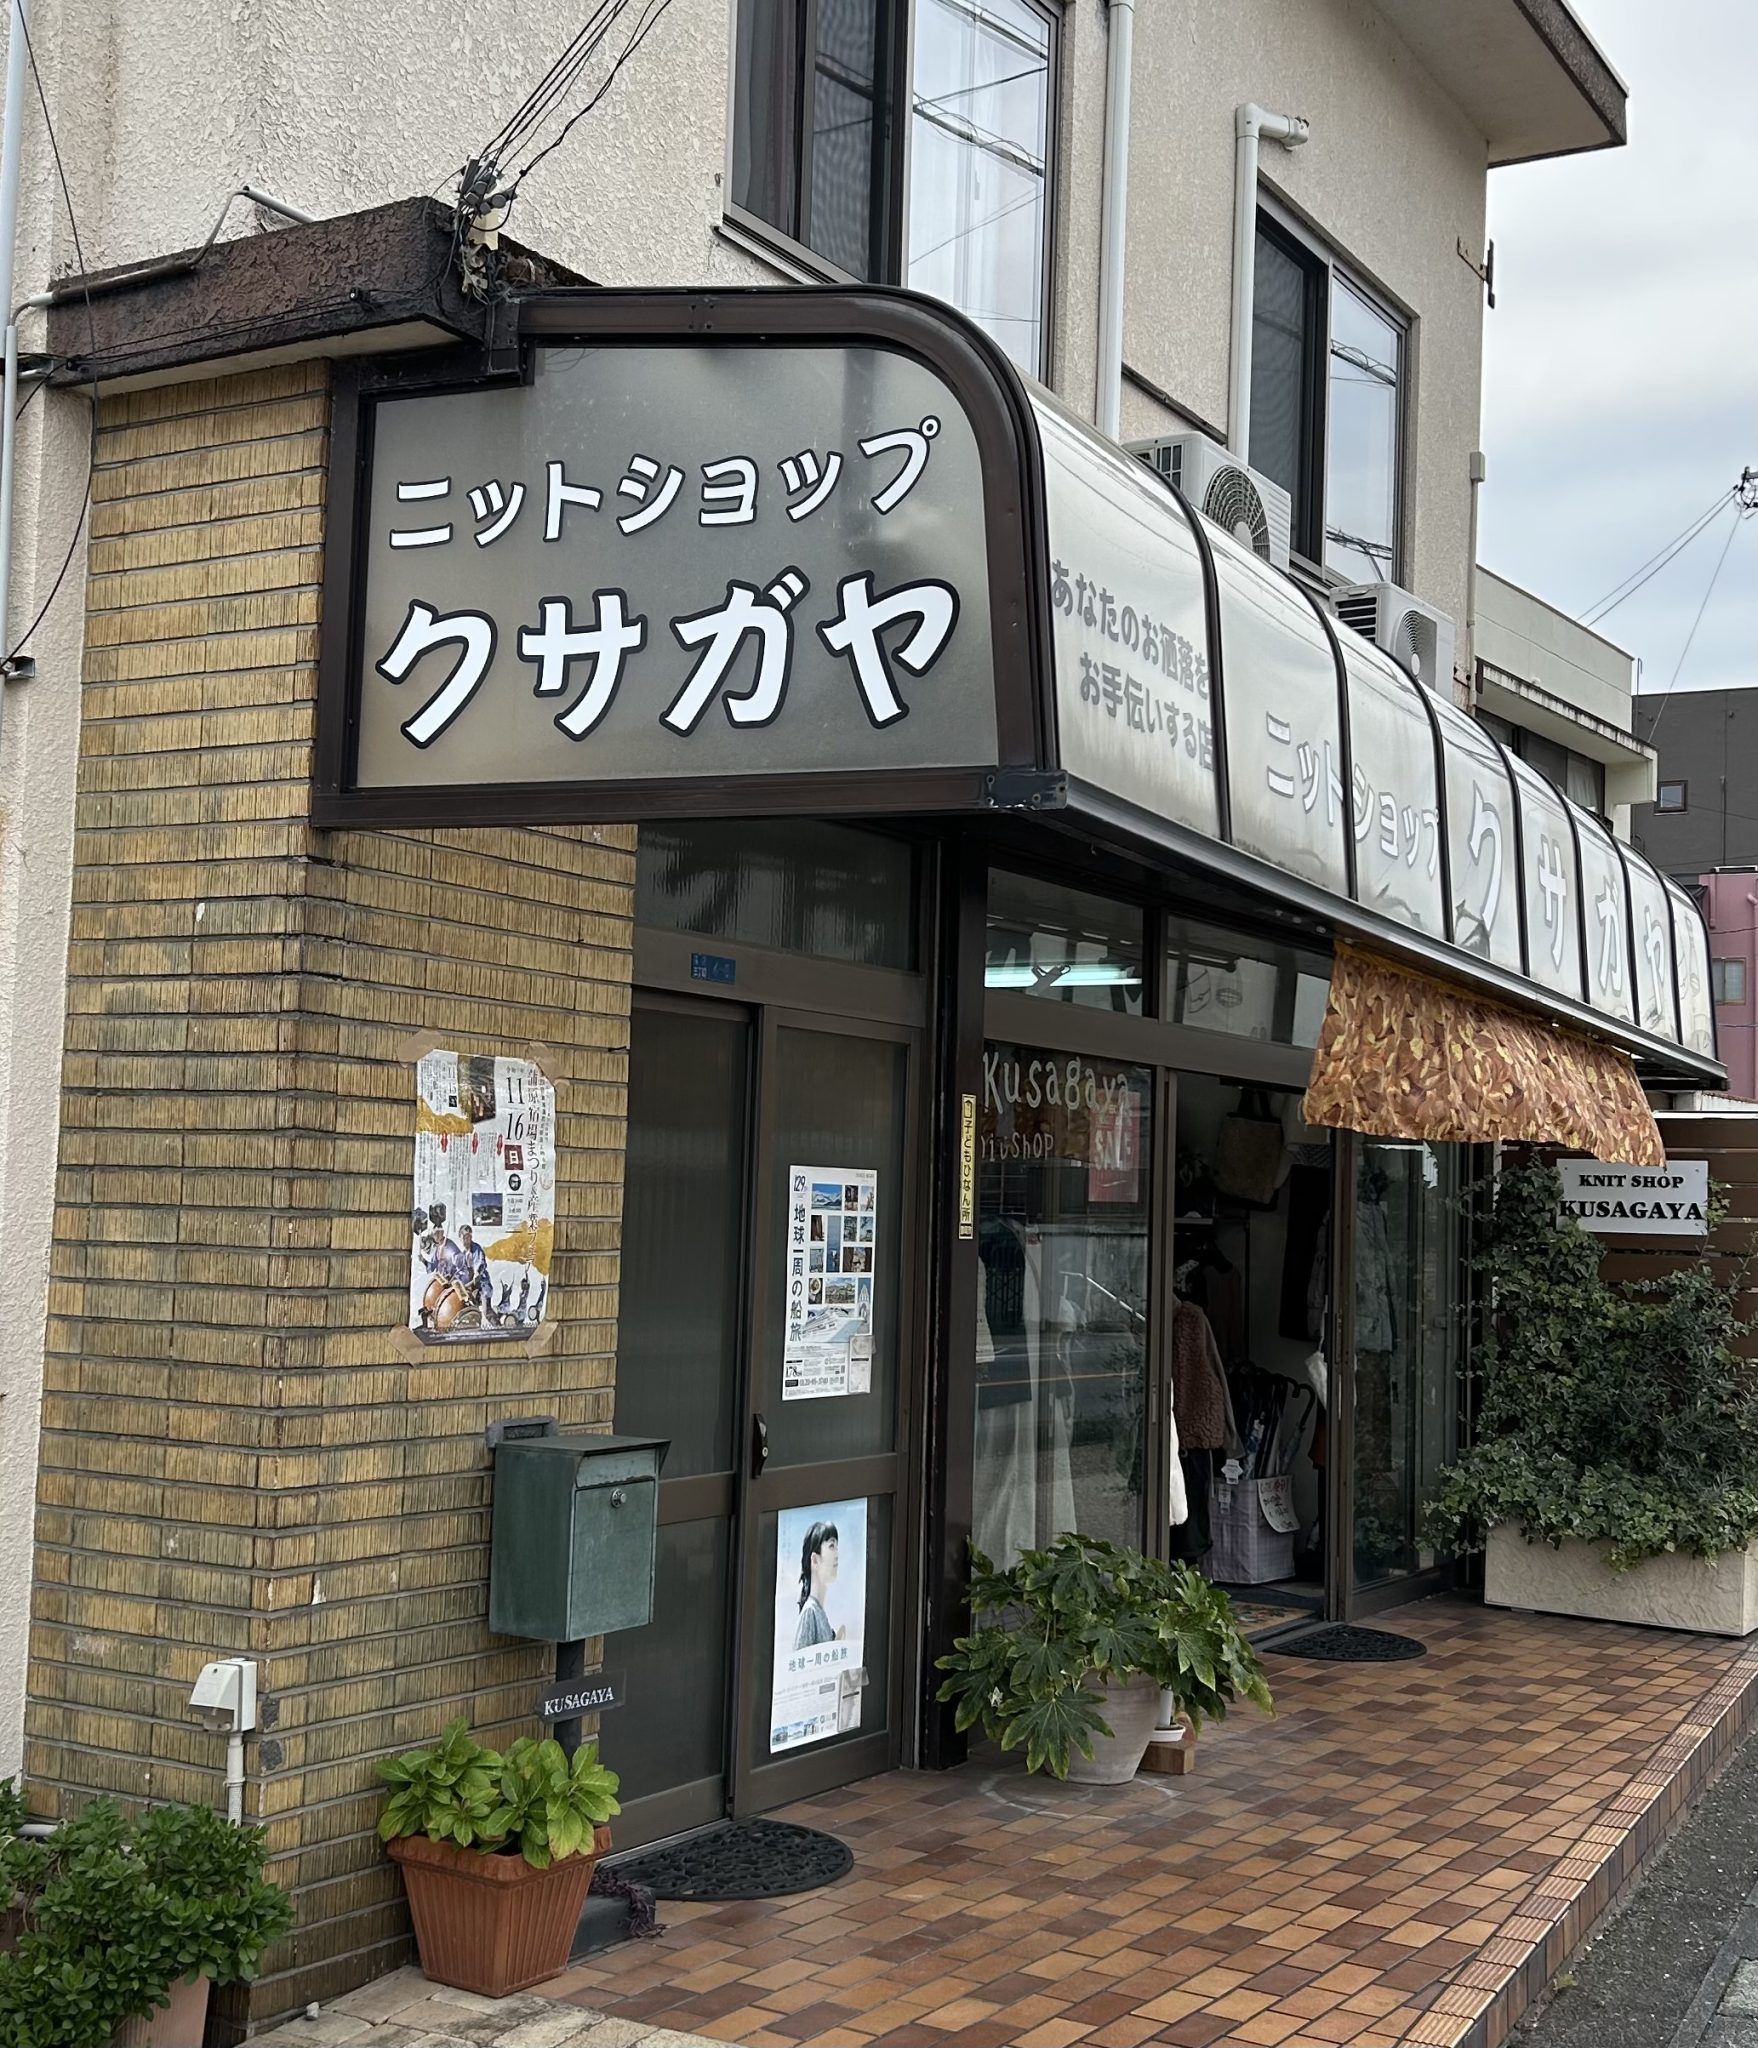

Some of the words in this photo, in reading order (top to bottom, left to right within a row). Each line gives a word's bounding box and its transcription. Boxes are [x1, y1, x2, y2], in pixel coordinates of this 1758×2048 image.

[390, 415, 940, 548] ニットショップ
[1052, 559, 1210, 701] あなたのお洒落を
[376, 565, 960, 748] クサガヤ
[1266, 711, 1440, 881] ニットショップ
[1467, 780, 1665, 1020] クサガヤ
[505, 1077, 525, 1105] 11
[983, 1052, 1129, 1122] Kusagaya
[505, 1112, 525, 1140] 16
[1578, 1174, 1627, 1188] KNIT
[1631, 1175, 1684, 1189] SHOP
[1559, 1200, 1704, 1220] KUSAGAYA
[790, 1203, 806, 1341] 地球一周の船旅
[788, 1647, 848, 1672] 地球一周の船旅
[543, 1686, 616, 1716] KUSAGAYA
